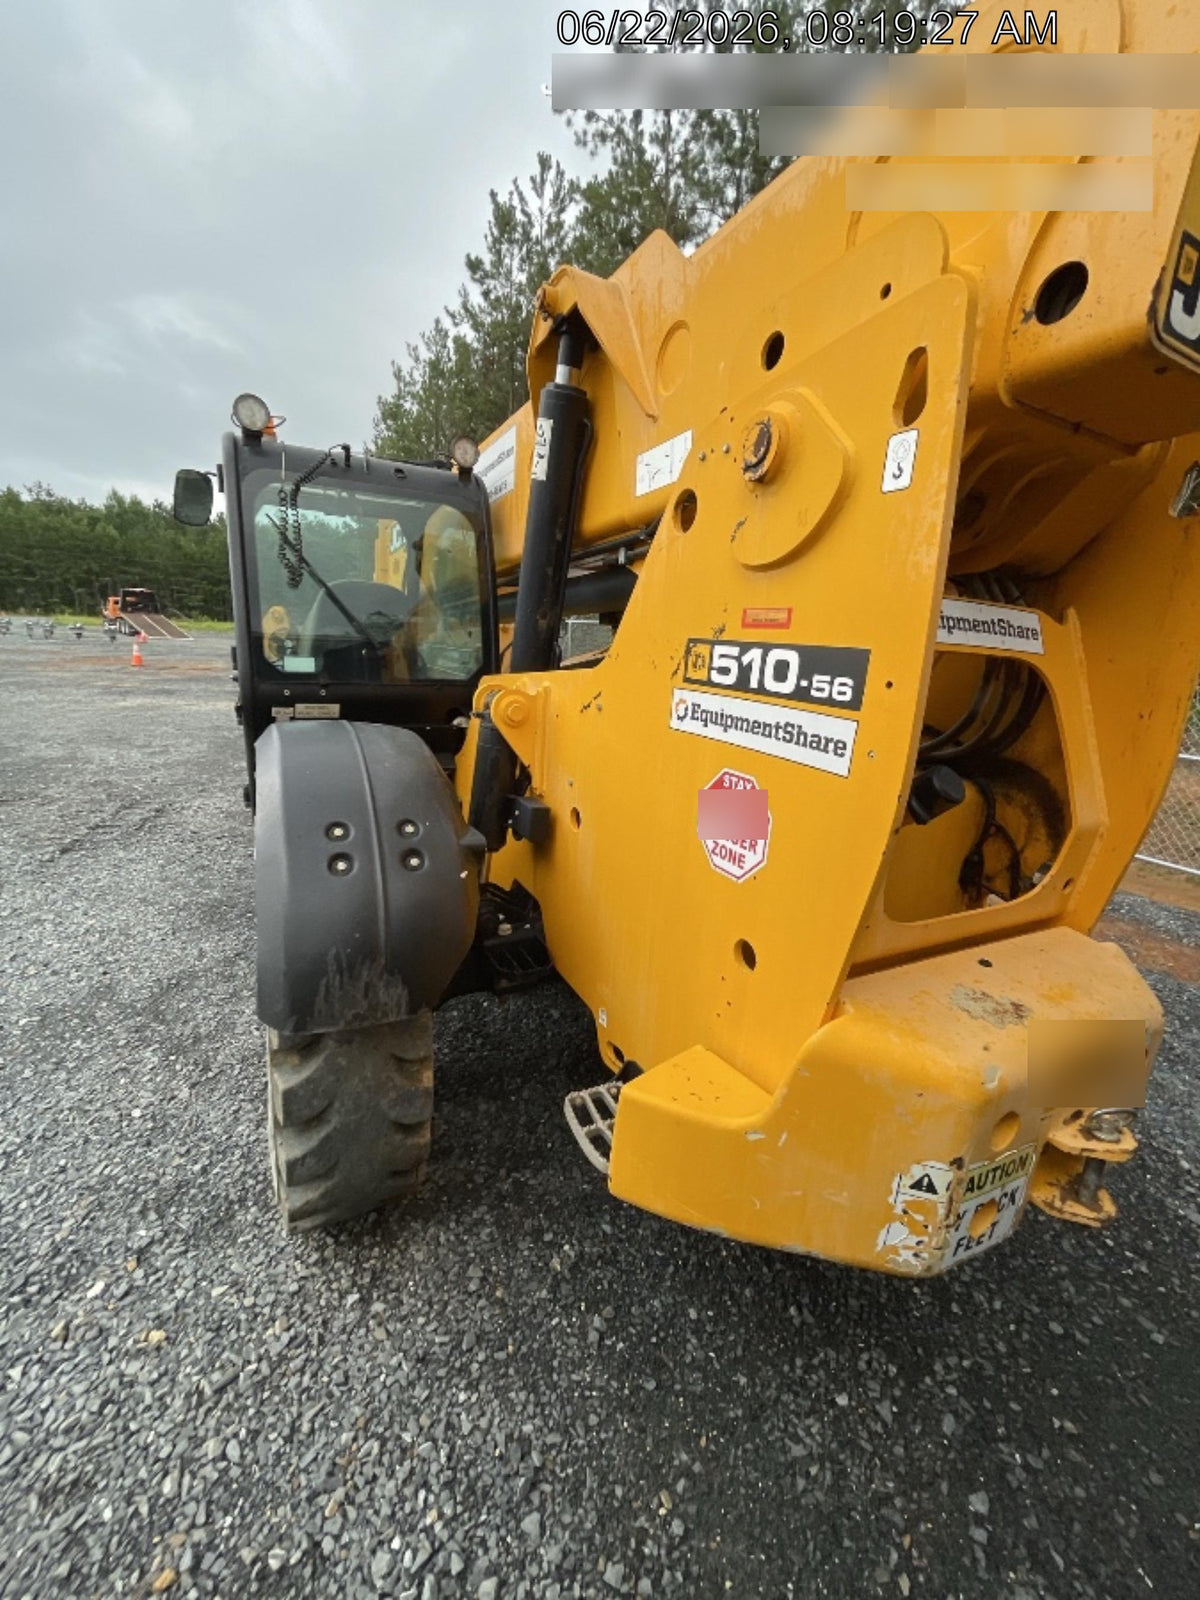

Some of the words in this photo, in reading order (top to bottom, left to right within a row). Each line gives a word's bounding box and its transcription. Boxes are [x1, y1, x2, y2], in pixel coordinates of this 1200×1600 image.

[938, 611, 1039, 641] ipmentShare
[690, 702, 848, 759] EquipmentShare
[722, 774, 753, 790] STAY
[711, 840, 746, 870] ZONE
[962, 1151, 1029, 1196] AUTION
